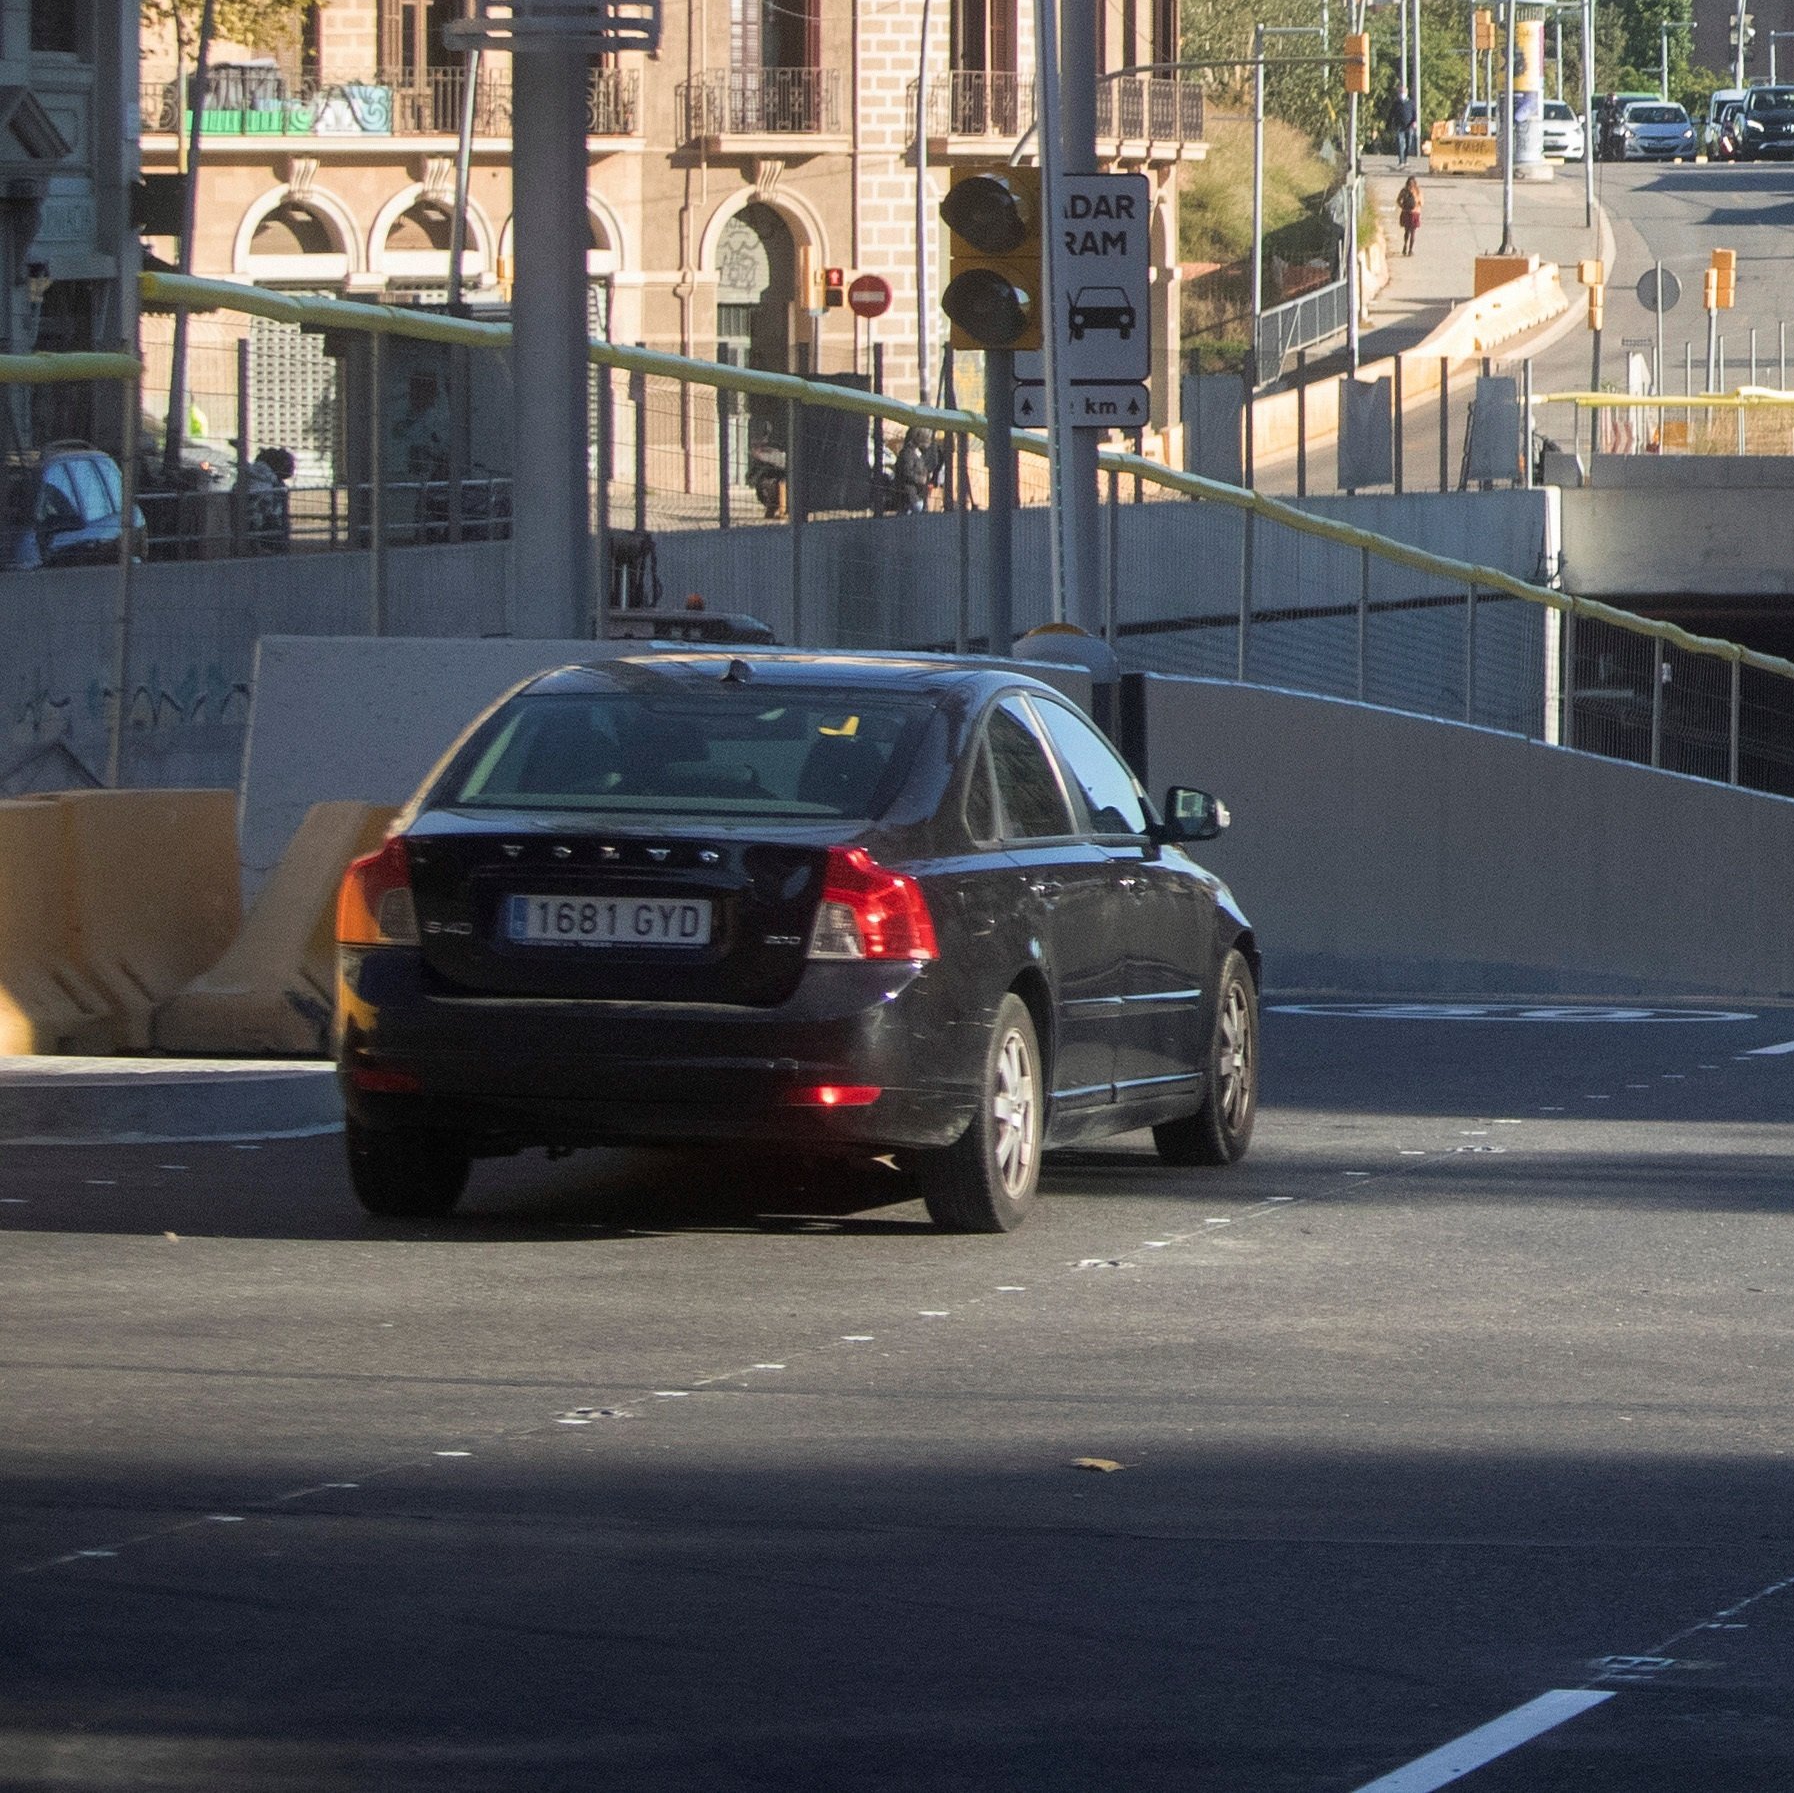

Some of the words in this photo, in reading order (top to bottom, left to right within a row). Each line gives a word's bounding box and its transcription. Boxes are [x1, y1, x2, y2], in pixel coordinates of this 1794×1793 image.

[1064, 194, 1136, 220] DAR
[1064, 231, 1128, 256] RAM
[1085, 397, 1118, 415] km
[537, 902, 617, 936] 1681
[633, 904, 699, 938] GYD
